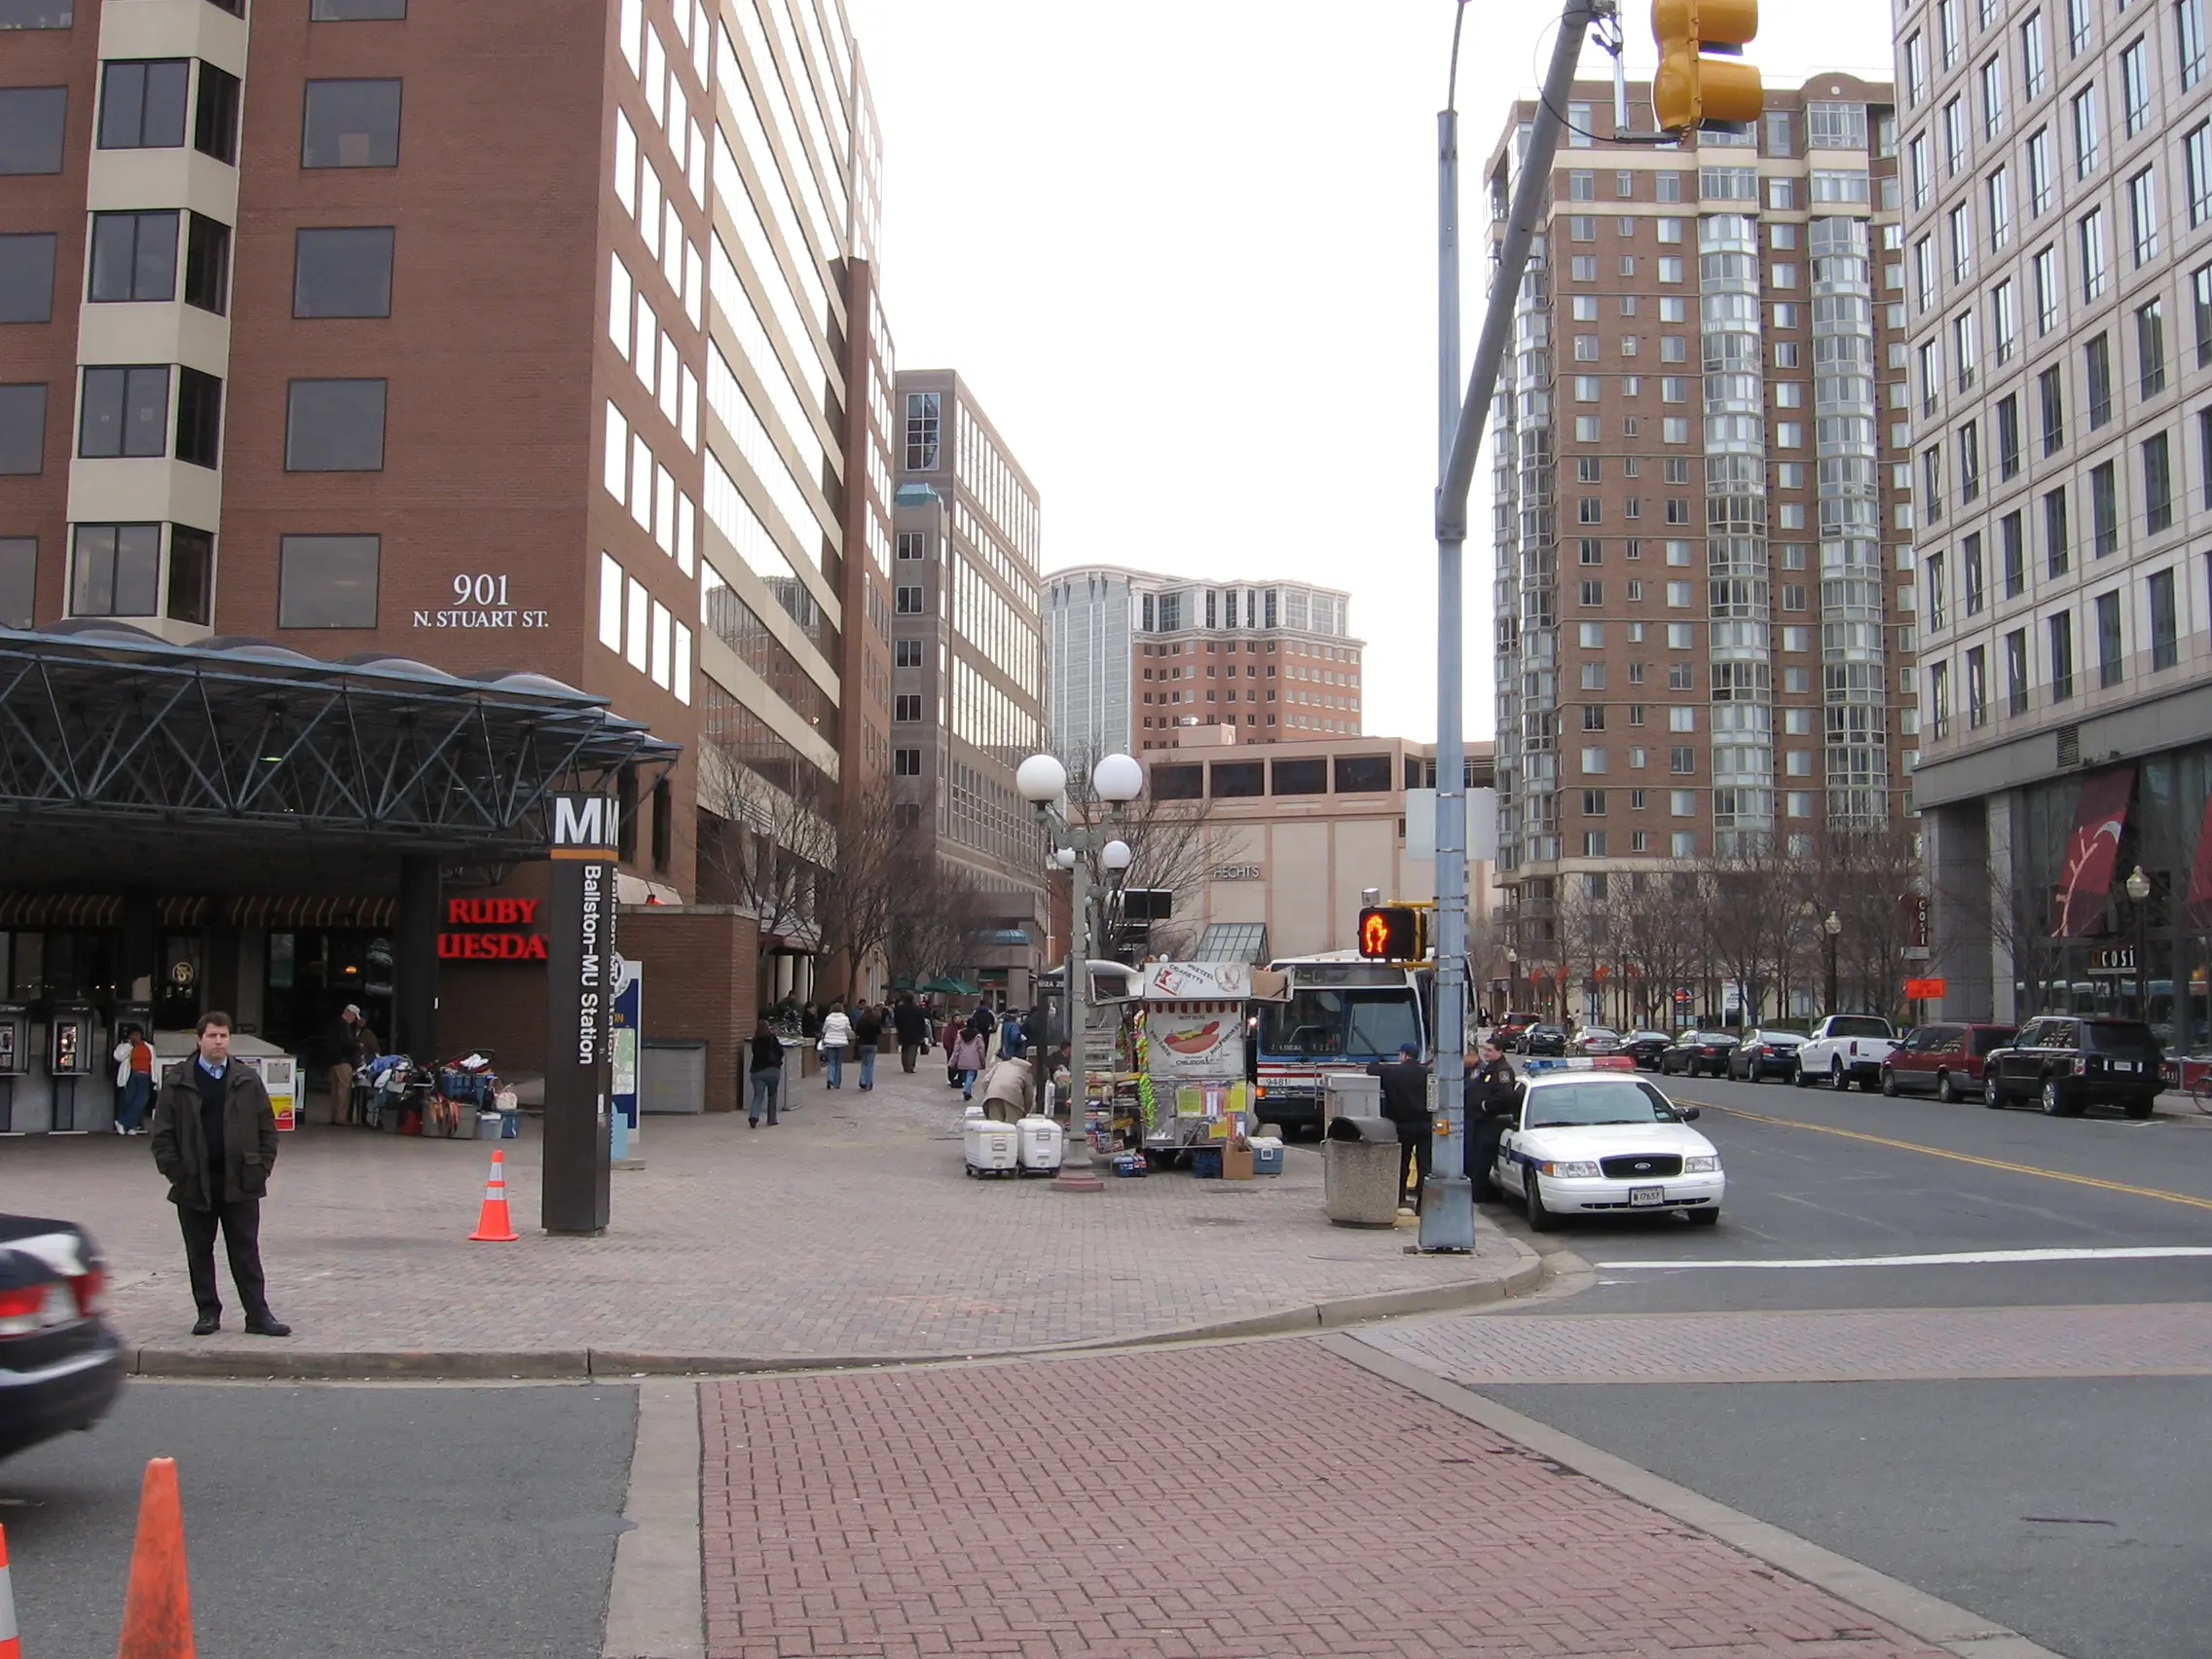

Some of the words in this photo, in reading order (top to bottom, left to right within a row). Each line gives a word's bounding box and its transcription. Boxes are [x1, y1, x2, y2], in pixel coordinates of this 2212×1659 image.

[453, 573, 509, 606] 901
[413, 610, 432, 628] N.
[436, 610, 517, 628] STUART
[522, 610, 549, 628] ST.
[554, 797, 602, 844] M
[605, 797, 620, 846] M
[448, 898, 541, 923] RUBY
[582, 866, 601, 986] Ballston-MU
[436, 933, 550, 959] UESDA
[579, 993, 599, 1064] Station
[1266, 1078, 1288, 1087] 9481
